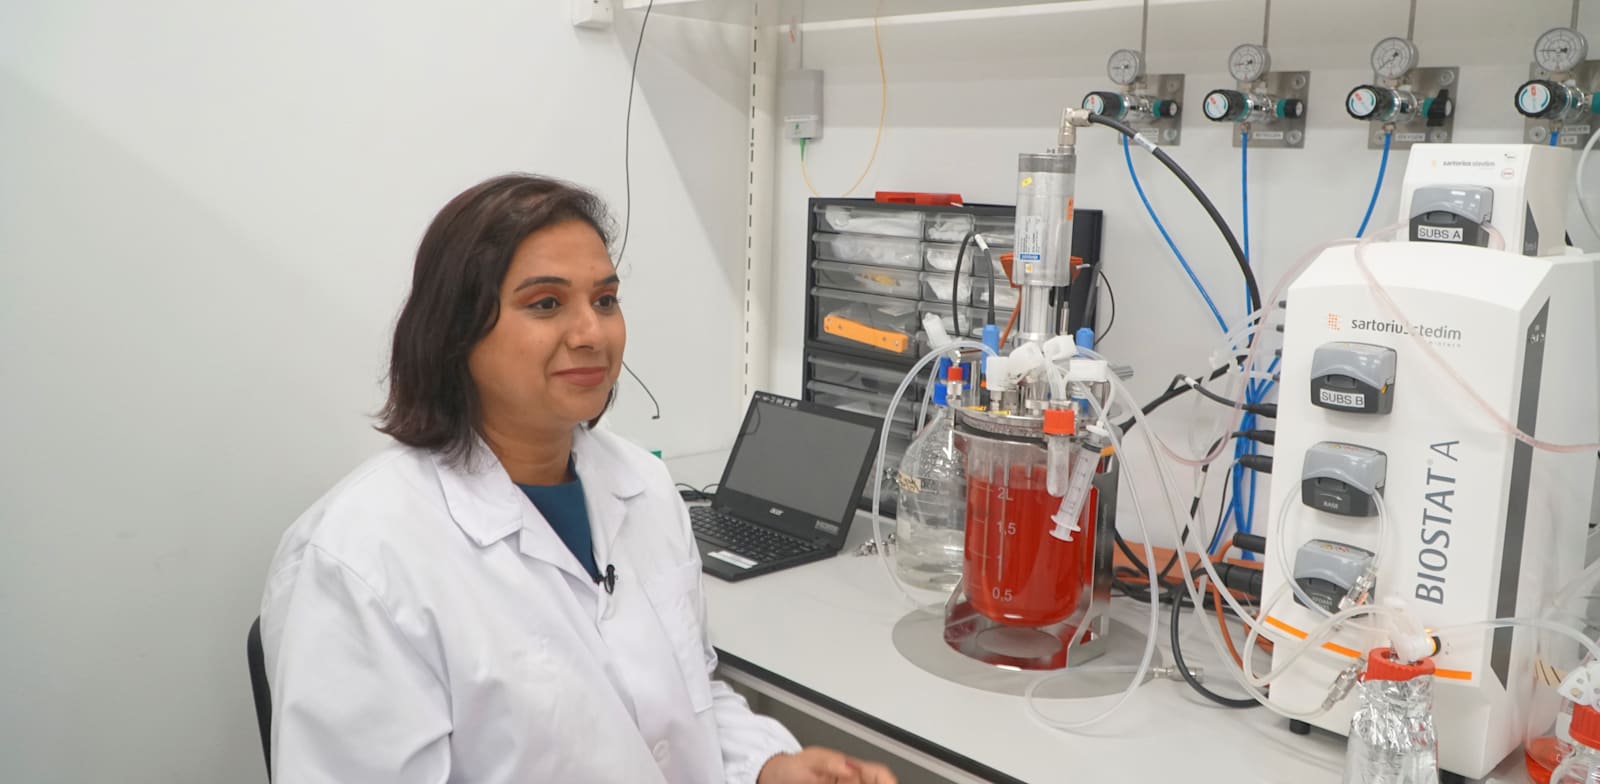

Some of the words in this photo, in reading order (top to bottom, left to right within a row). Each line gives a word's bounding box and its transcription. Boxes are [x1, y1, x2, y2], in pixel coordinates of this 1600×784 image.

[1419, 227, 1449, 239] SUBS
[1452, 230, 1461, 240] A
[1321, 391, 1352, 405] SUBS
[1355, 396, 1363, 406] B
[1430, 440, 1460, 462] A
[1415, 467, 1456, 605] BIOSTAT
